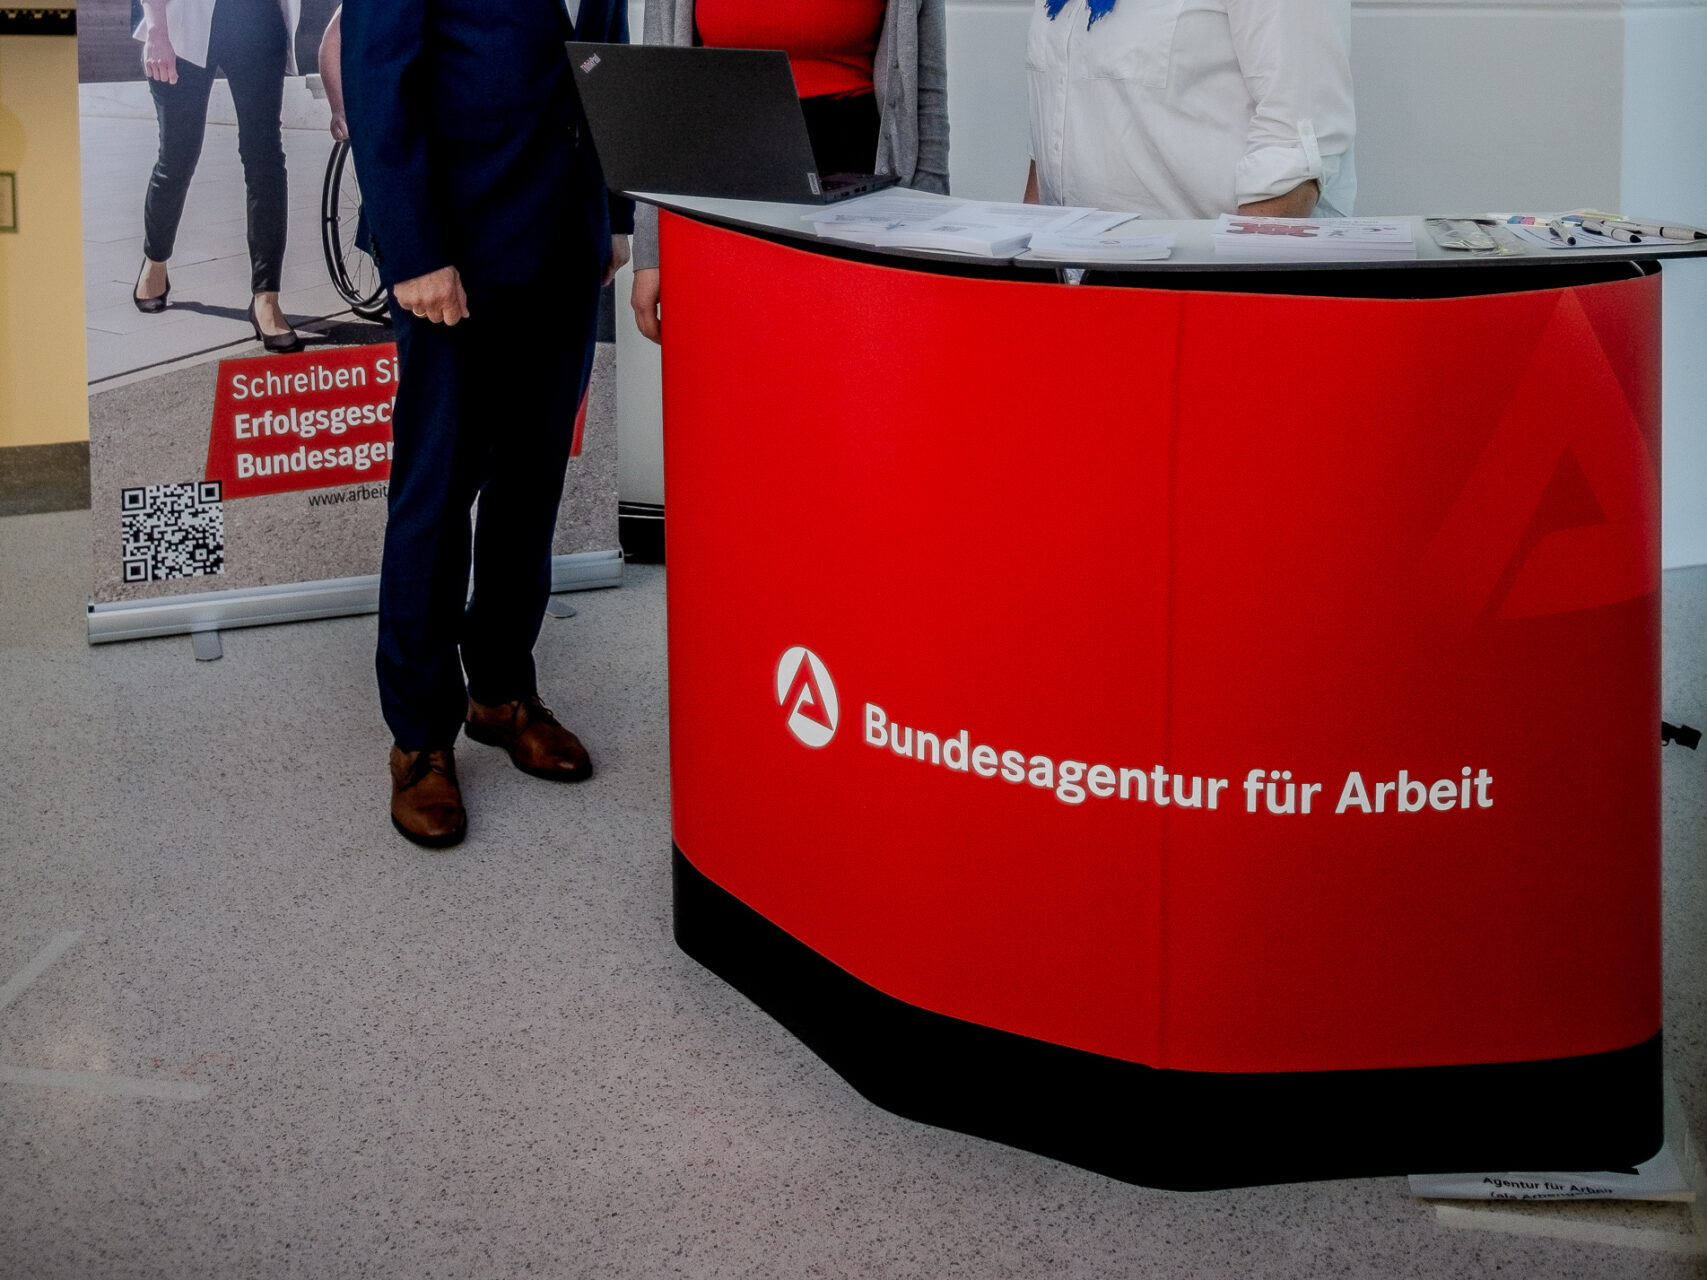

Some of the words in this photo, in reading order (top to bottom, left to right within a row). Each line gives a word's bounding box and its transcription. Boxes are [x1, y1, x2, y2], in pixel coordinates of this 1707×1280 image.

[232, 365, 367, 400] Schreiben
[375, 357, 399, 384] Si
[235, 396, 396, 440] Erfolgsgesc
[308, 485, 388, 507] www.arbeit
[864, 702, 1229, 810] Bundesagentur
[1243, 768, 1322, 815] für
[1334, 766, 1495, 815] Arbeit
[1483, 1177, 1540, 1190] Agentur
[1544, 1181, 1564, 1191] für
